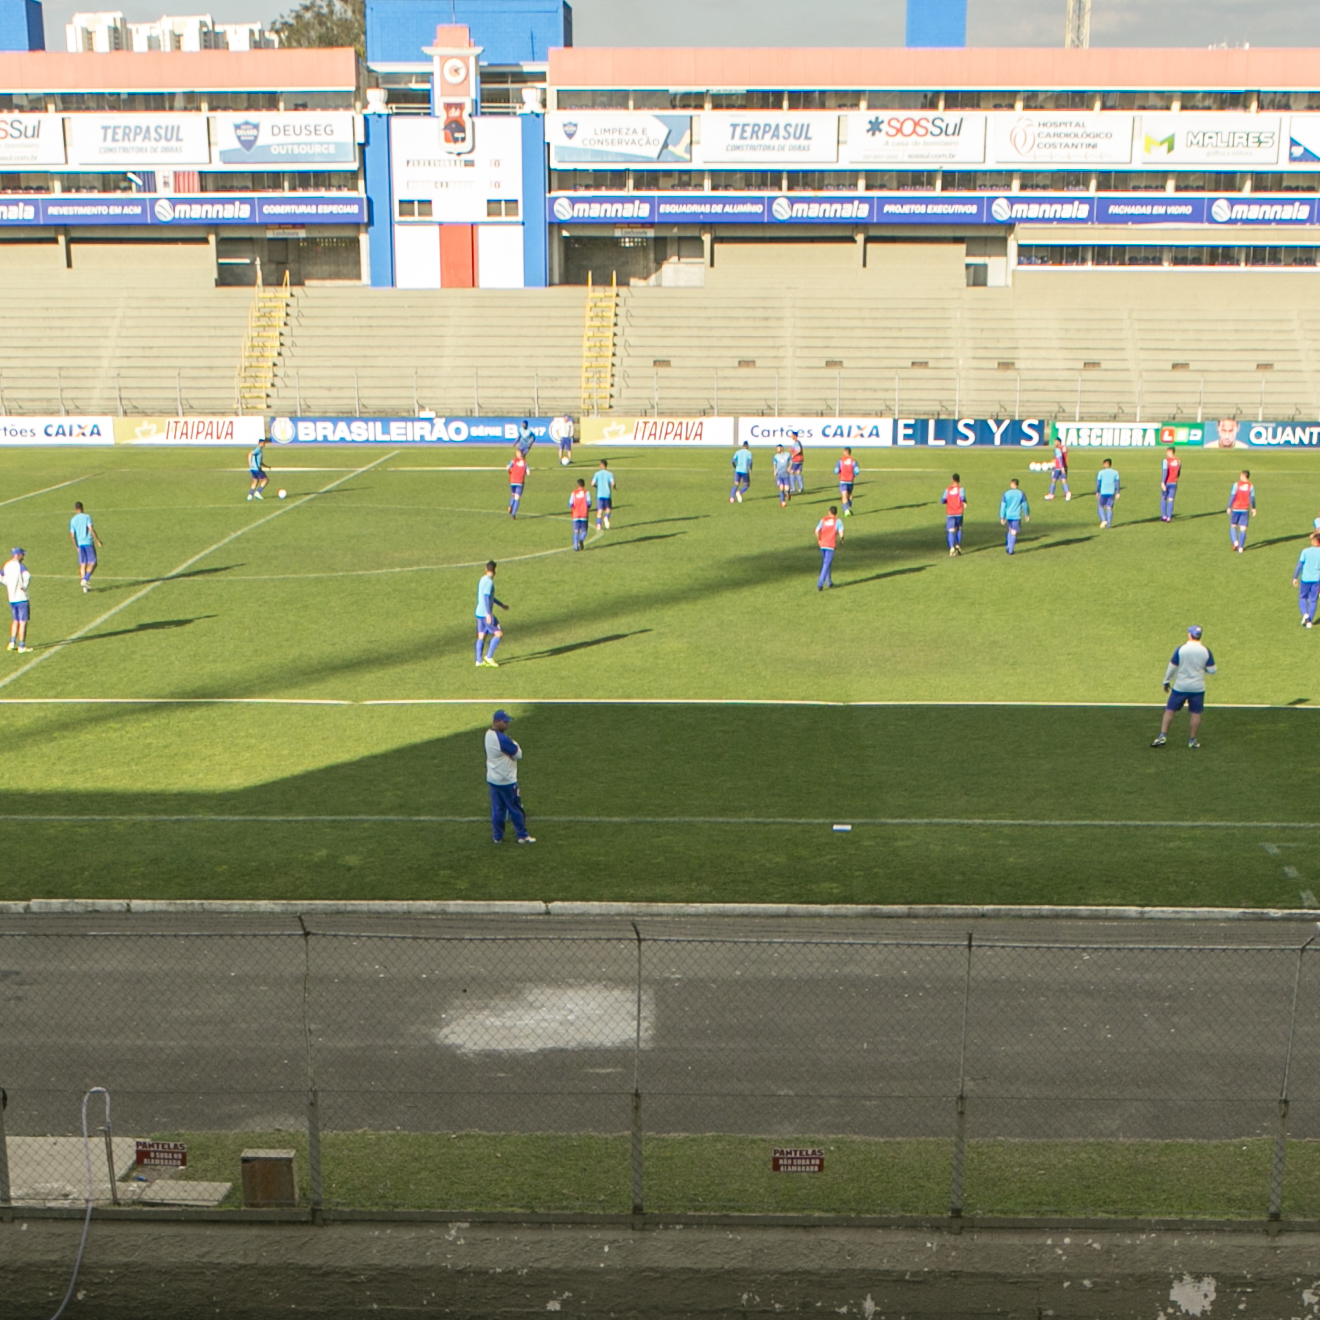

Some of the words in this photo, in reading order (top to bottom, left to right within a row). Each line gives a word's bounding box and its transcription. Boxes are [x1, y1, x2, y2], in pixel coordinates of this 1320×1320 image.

[101, 125, 183, 142] TERPASUL
[271, 125, 334, 136] DEUSEG
[594, 127, 638, 135] LIMPEZA
[730, 123, 812, 140] TERPASUL
[1038, 130, 1112, 139] CARDIOLÓGICO
[582, 136, 660, 147] CONSERVAÇÃO
[1186, 131, 1275, 147] MALIRES
[99, 146, 148, 154] CONSTRUTORA
[271, 144, 335, 154] OUTSOURCE
[726, 144, 776, 152] CONSTRUTORA
[263, 205, 318, 213] COBERTURAS
[320, 205, 358, 213] ESPECIAIS
[660, 204, 709, 213] ESQUADRIAS
[711, 204, 722, 213] DE
[723, 202, 763, 213] ALUMÍNIO
[883, 205, 925, 214] PROJETOS
[927, 205, 977, 213] EXECUTIVOS
[1109, 205, 1151, 214] FACHADAS
[1153, 205, 1166, 214] EM
[1167, 205, 1192, 214] VIDRO
[44, 424, 101, 437] CAIXA
[166, 421, 234, 440] ITAIPAVA
[298, 418, 468, 441] BRASILEIRÃO
[505, 424, 519, 439] B
[634, 421, 703, 440] ITAIPAVA
[751, 425, 813, 438] Cartões
[822, 425, 880, 438] CAIXA
[898, 418, 1039, 446] ELSYS
[1056, 422, 1161, 446] TASCHIBRA
[136, 1141, 185, 1150] PANTELAS
[773, 1149, 823, 1157] PANTELAS
